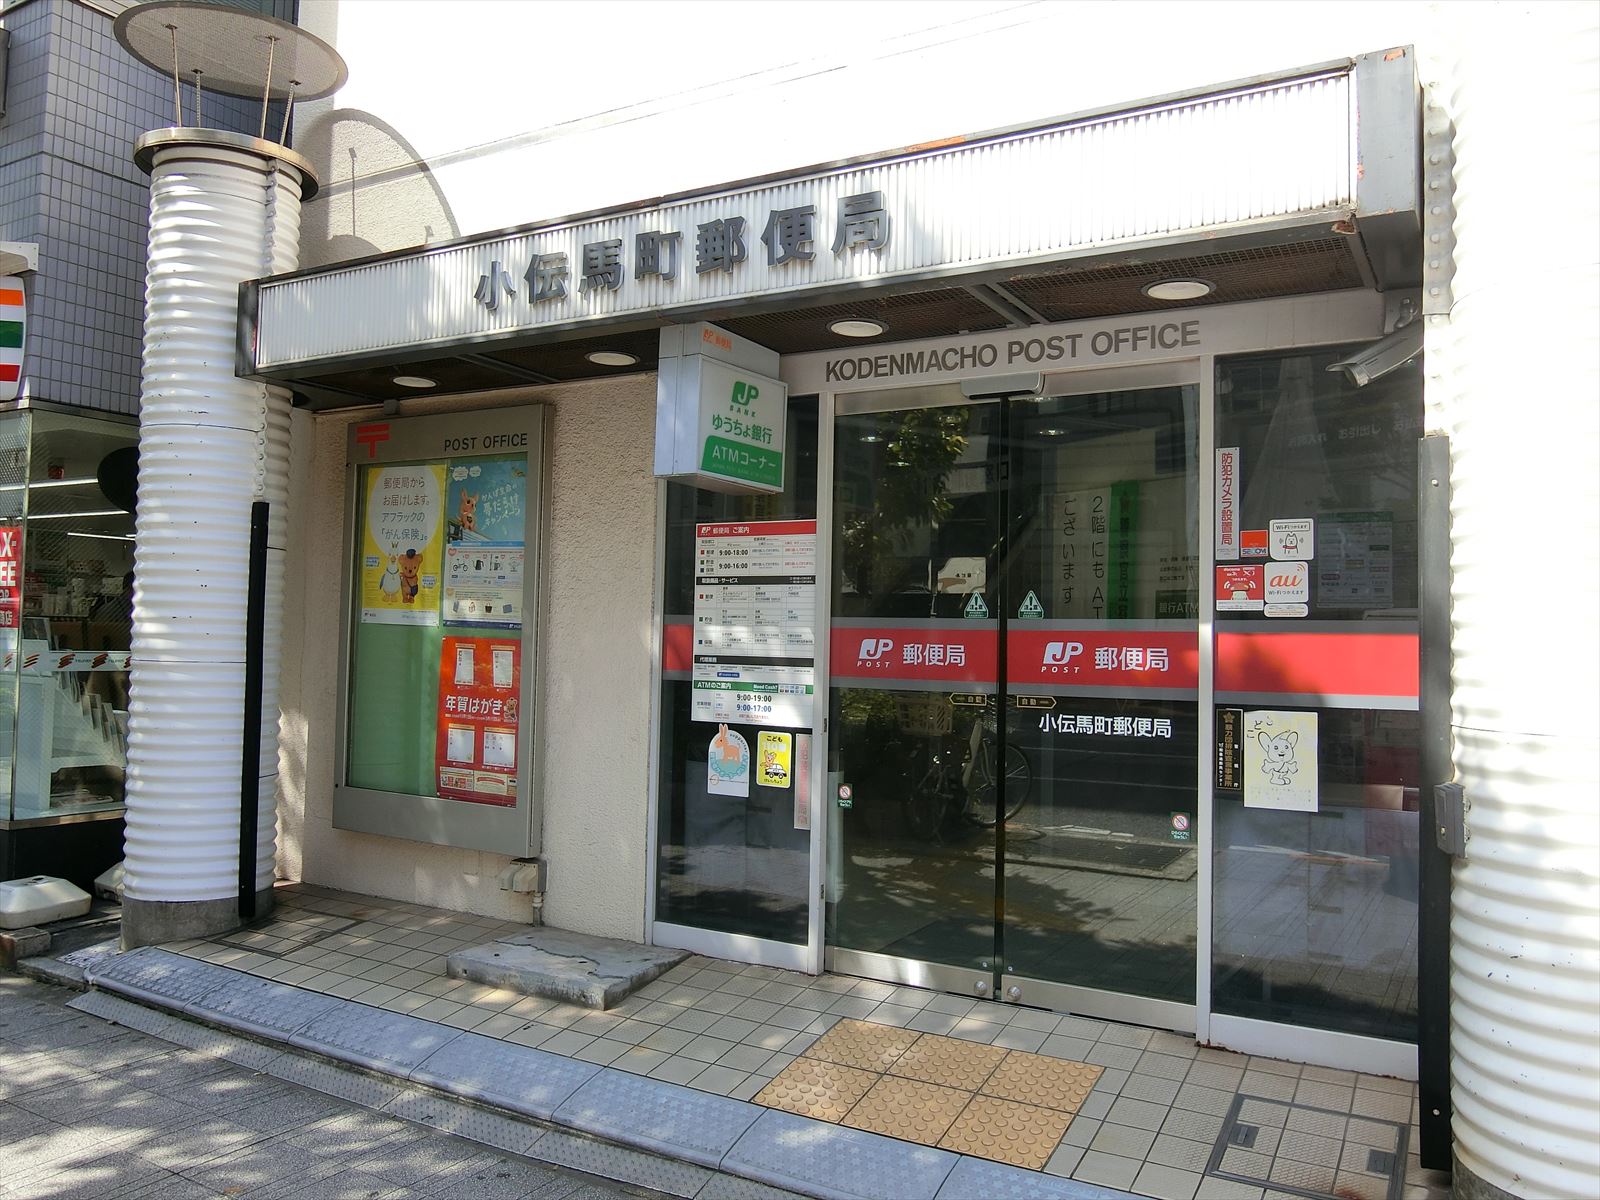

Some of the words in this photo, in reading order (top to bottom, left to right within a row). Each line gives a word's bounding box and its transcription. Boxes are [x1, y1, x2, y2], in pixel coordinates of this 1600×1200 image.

[474, 190, 890, 314] 小伝馬町郵便局
[825, 342, 997, 382] KODENMACHO
[1007, 333, 1083, 365] POST
[1091, 320, 1201, 356] OFFICE
[729, 404, 757, 418] BANK
[712, 413, 773, 445] ゆうちょ銀行
[444, 436, 477, 451] POST
[483, 432, 528, 449] OFFICE
[711, 444, 777, 470] ATMコーナー
[383, 476, 426, 490] 郵便局から
[383, 494, 430, 507] お届けします。
[1220, 452, 1233, 546] 防犯カメラ設置局
[381, 511, 426, 523] アフラックの
[380, 527, 429, 542] 「がん保険」。
[732, 526, 750, 534] ご案内
[0, 531, 17, 558] X-
[719, 549, 749, 557] 9:00-18:00
[718, 562, 748, 570] 9:00-16:00
[1269, 575, 1303, 588] au
[902, 643, 966, 667] 郵便局
[1094, 647, 1169, 672] 郵便局
[1040, 666, 1081, 674] POST
[697, 681, 732, 690] ATMのご案内
[445, 694, 503, 715] 年賀はがき
[736, 693, 772, 703] 9:00-19:00
[736, 703, 772, 713] 9:00-17:00
[1039, 713, 1172, 738] 小伝馬町郵便局
